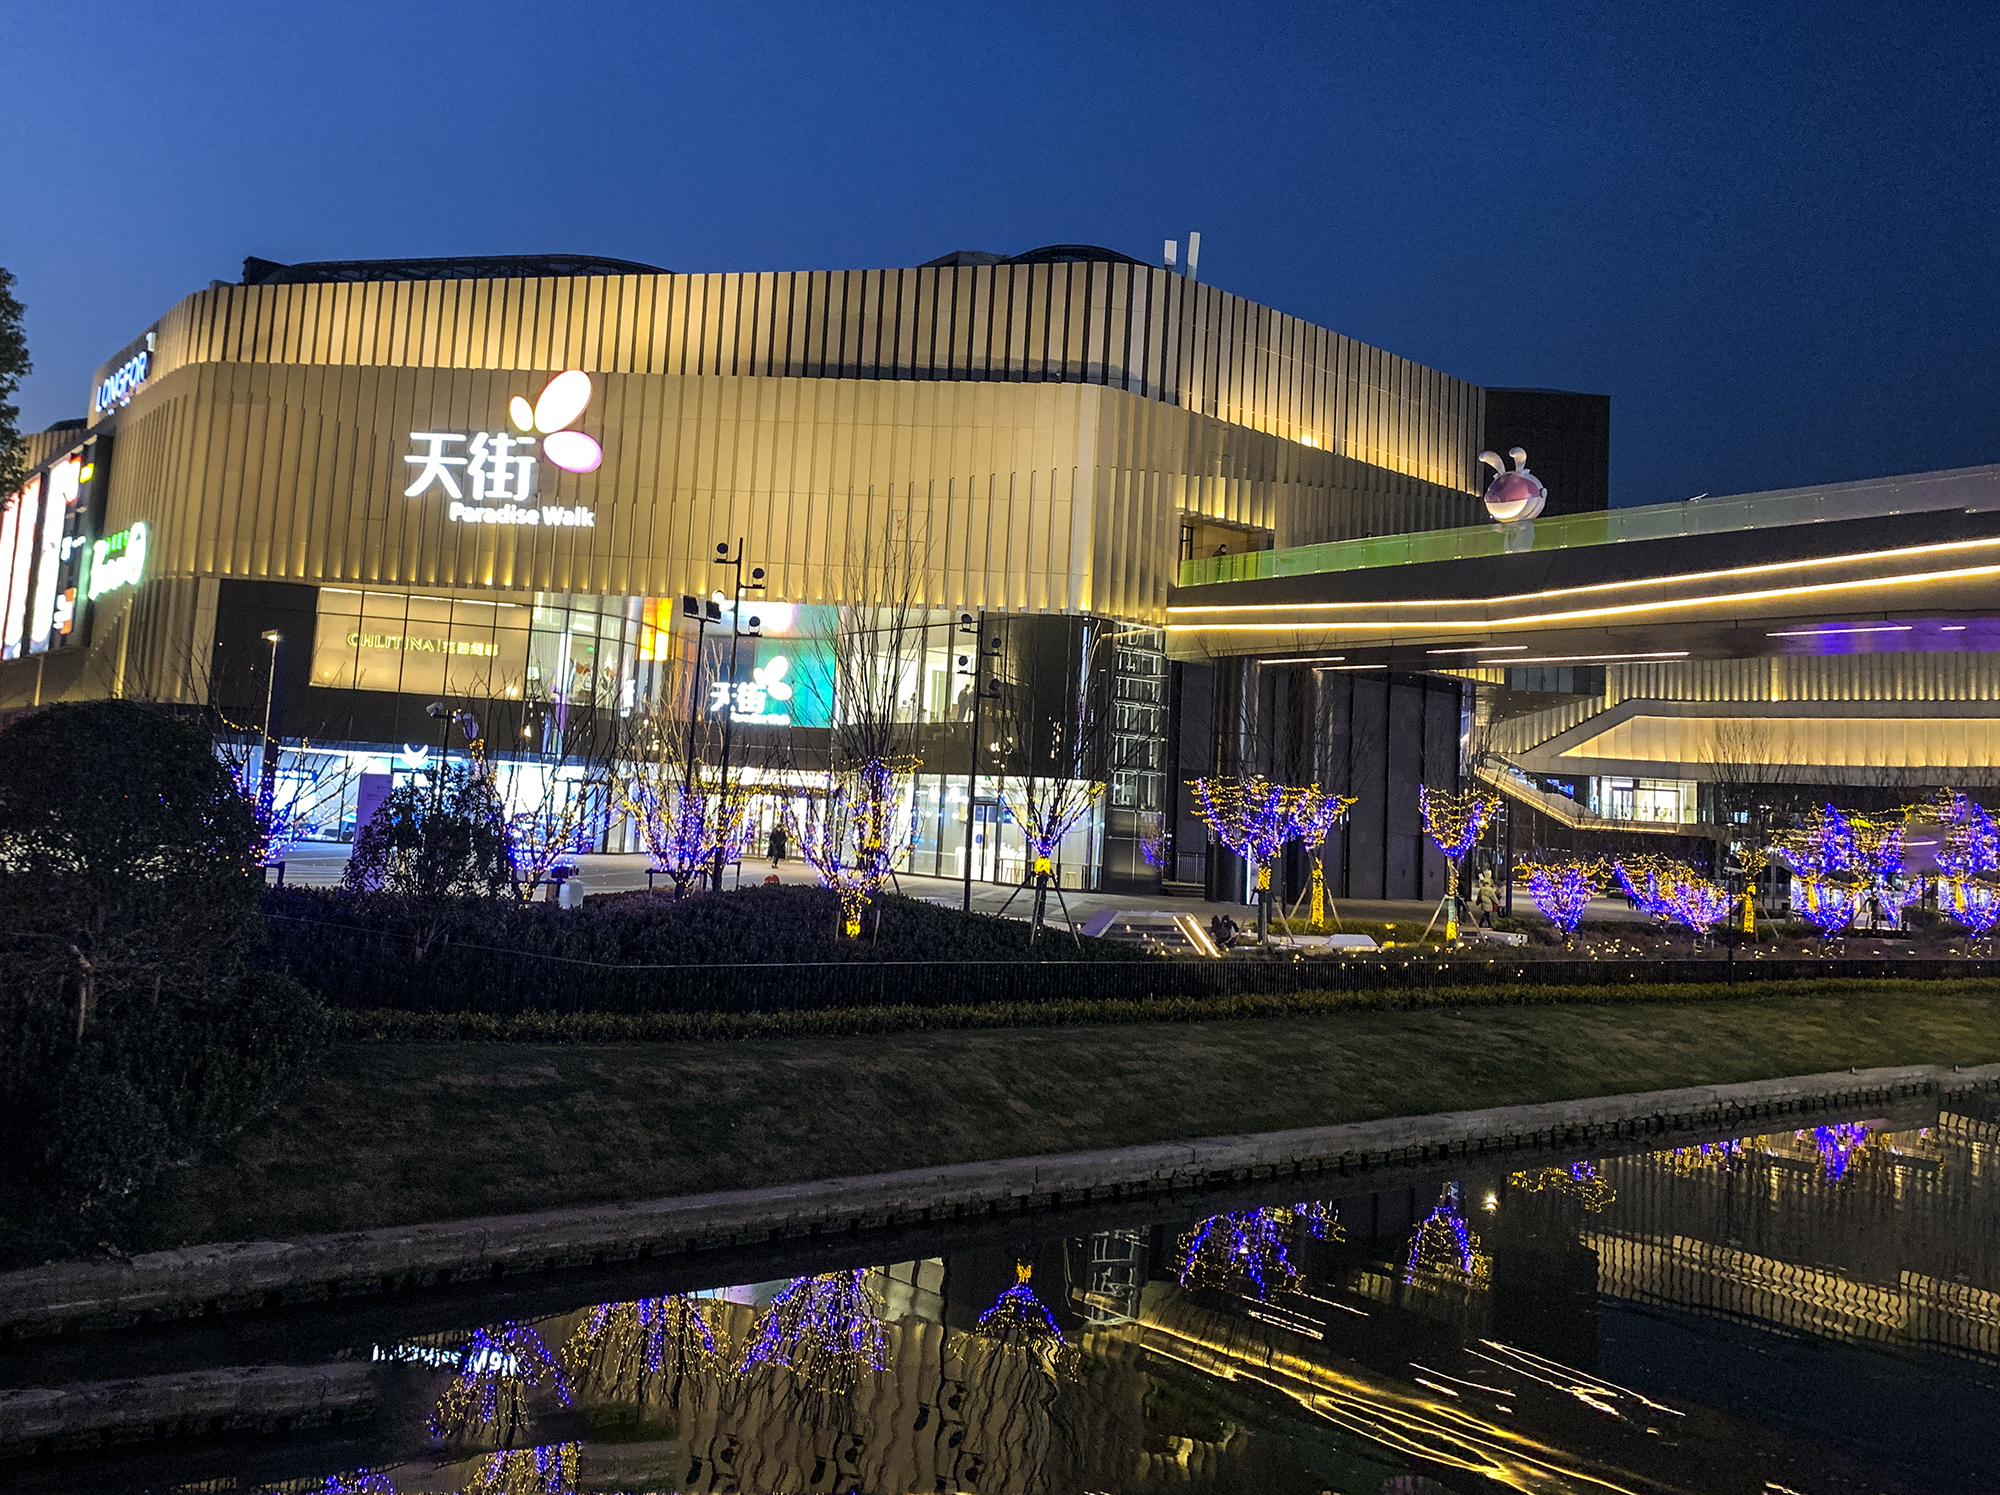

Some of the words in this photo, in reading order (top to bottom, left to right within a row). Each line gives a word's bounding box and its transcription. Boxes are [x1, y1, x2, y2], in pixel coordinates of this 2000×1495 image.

[95, 350, 148, 414] LONGFOR
[403, 431, 537, 501] 天街
[449, 501, 540, 526] Paradise
[541, 505, 596, 527] Walk
[347, 633, 434, 653] CHLITINA
